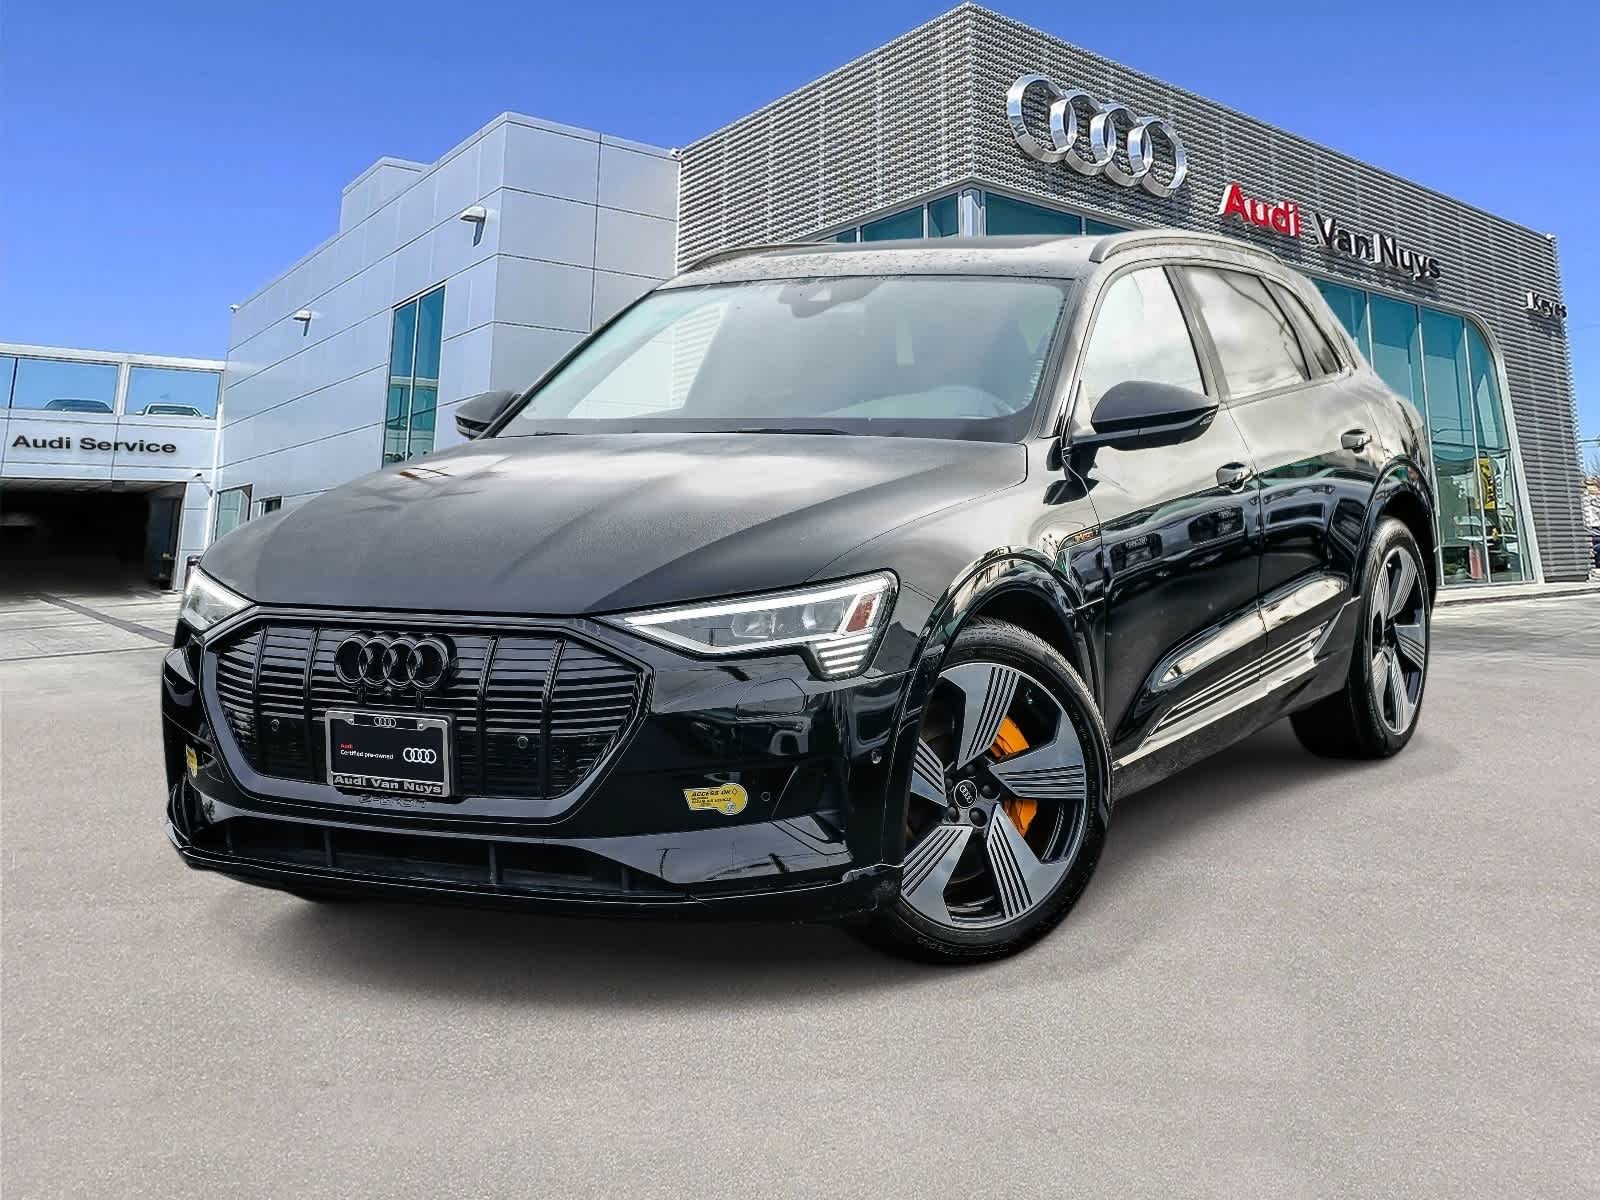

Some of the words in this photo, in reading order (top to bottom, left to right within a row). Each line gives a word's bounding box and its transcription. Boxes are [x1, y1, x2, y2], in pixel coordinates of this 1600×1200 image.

[1218, 182, 1302, 239] Audi
[1312, 211, 1374, 260] Van
[1373, 232, 1442, 281] Nuys
[12, 435, 71, 450] Audi
[79, 437, 177, 454] Service
[334, 775, 366, 786] Audi
[370, 778, 399, 790] Van
[403, 781, 442, 794] Nuys
